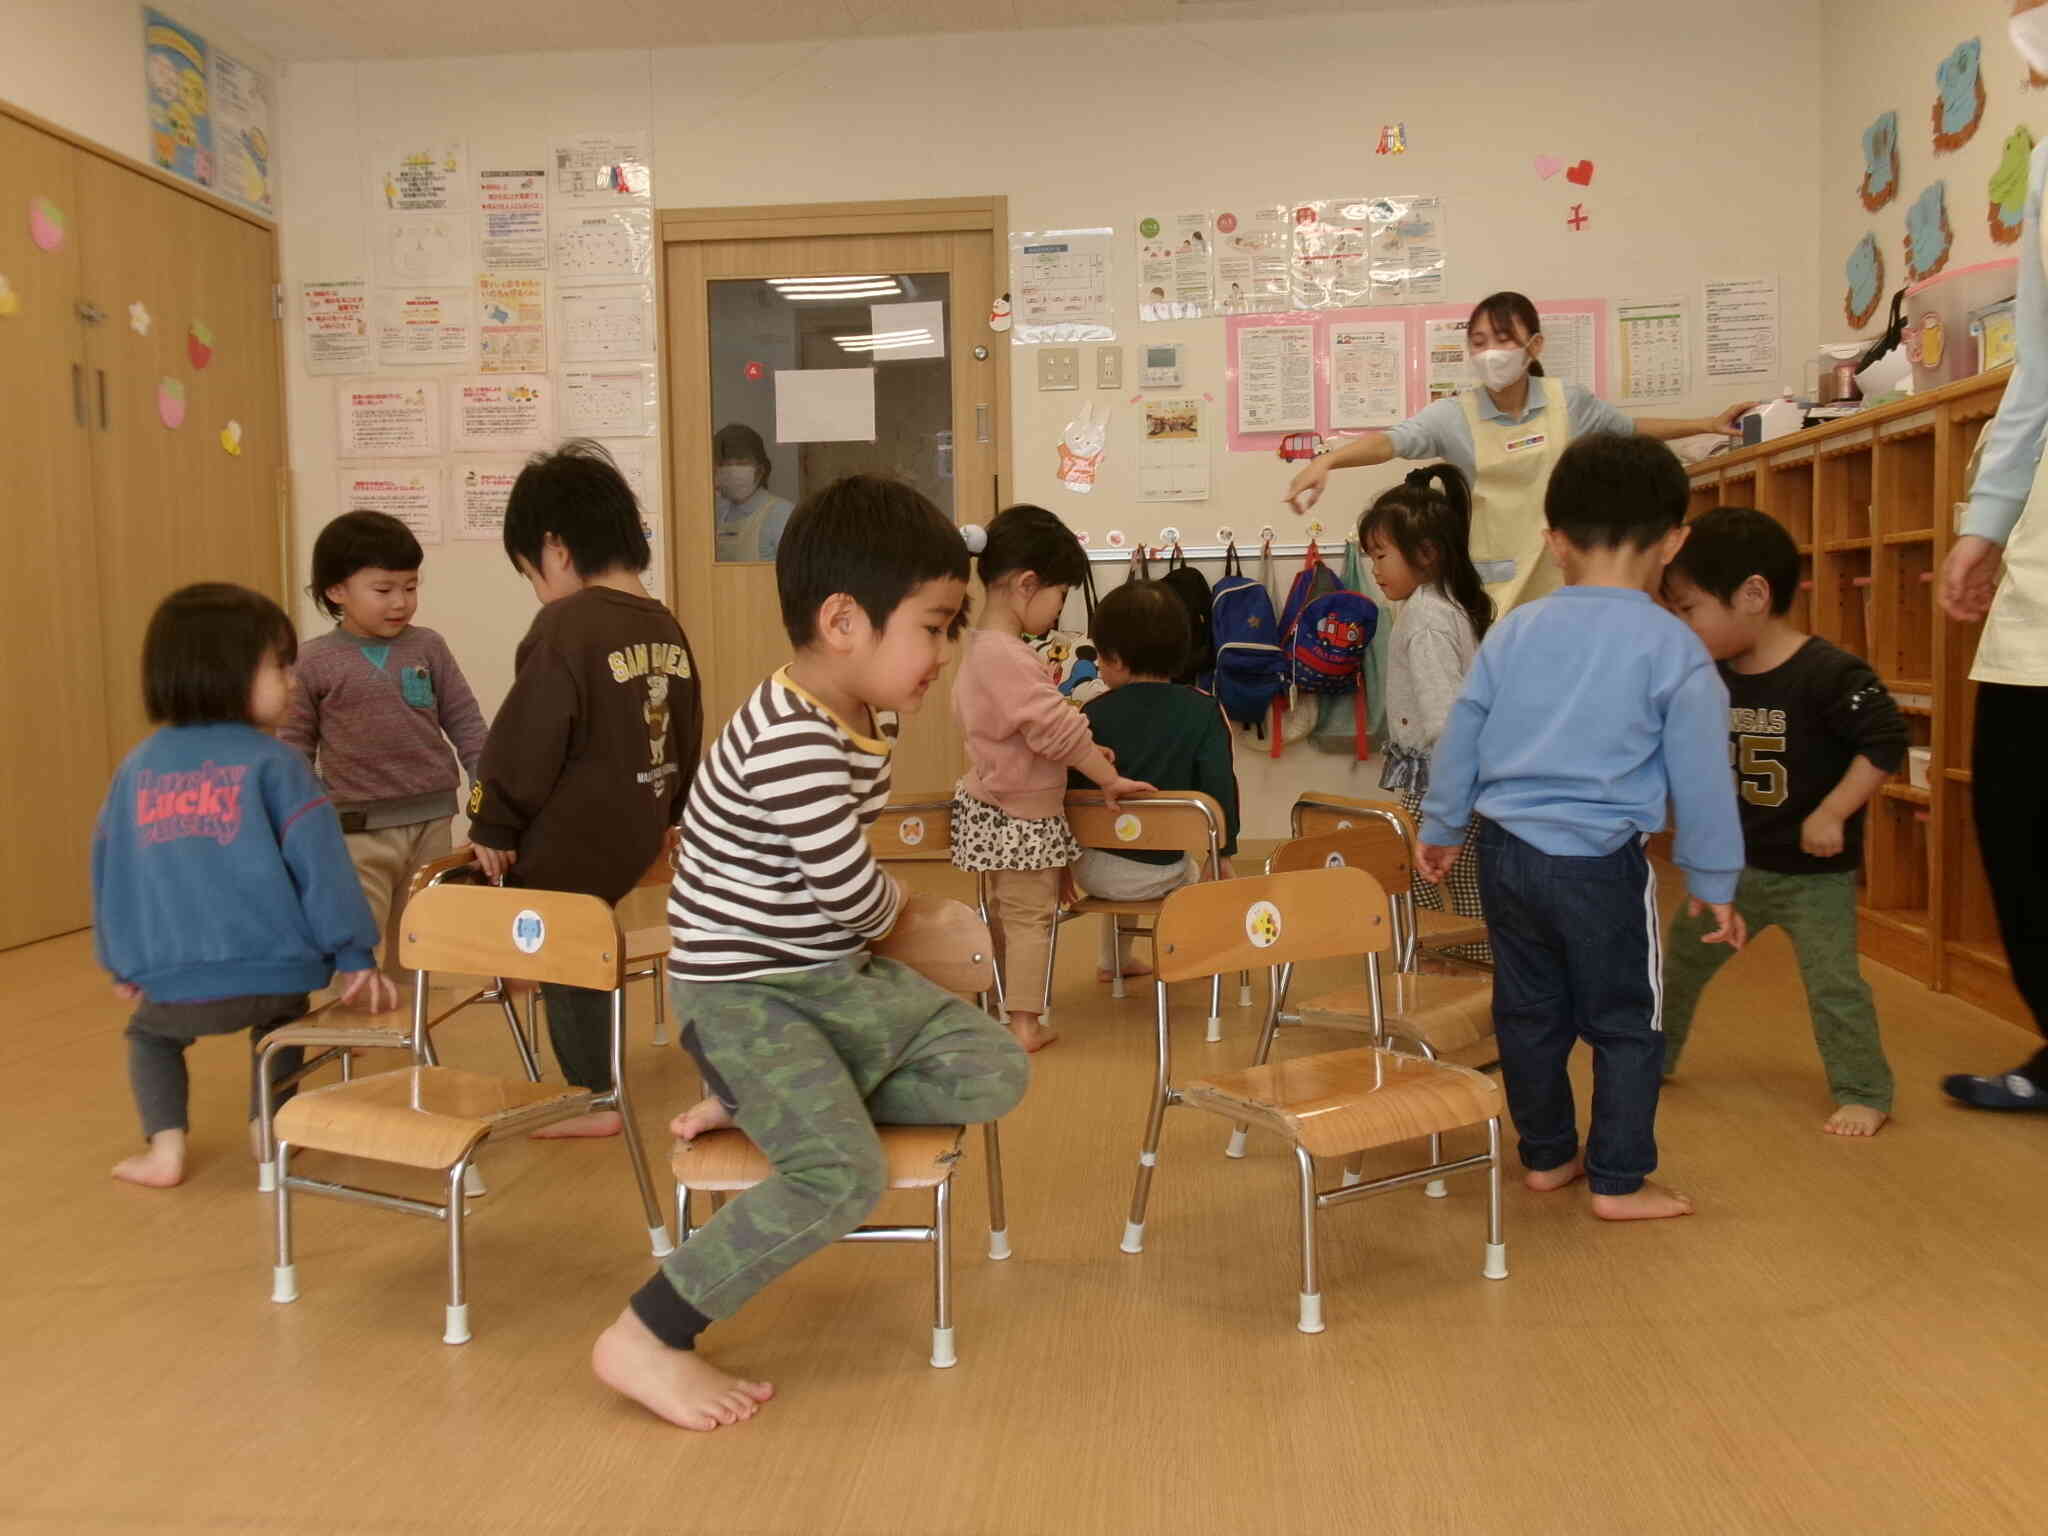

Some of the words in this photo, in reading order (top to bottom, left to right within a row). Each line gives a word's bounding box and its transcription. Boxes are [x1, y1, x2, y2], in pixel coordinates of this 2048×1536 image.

[608, 643, 649, 683] SAN
[1728, 708, 1786, 733] NSAS
[1728, 734, 1788, 807] 5
[137, 780, 241, 825] Lucky
